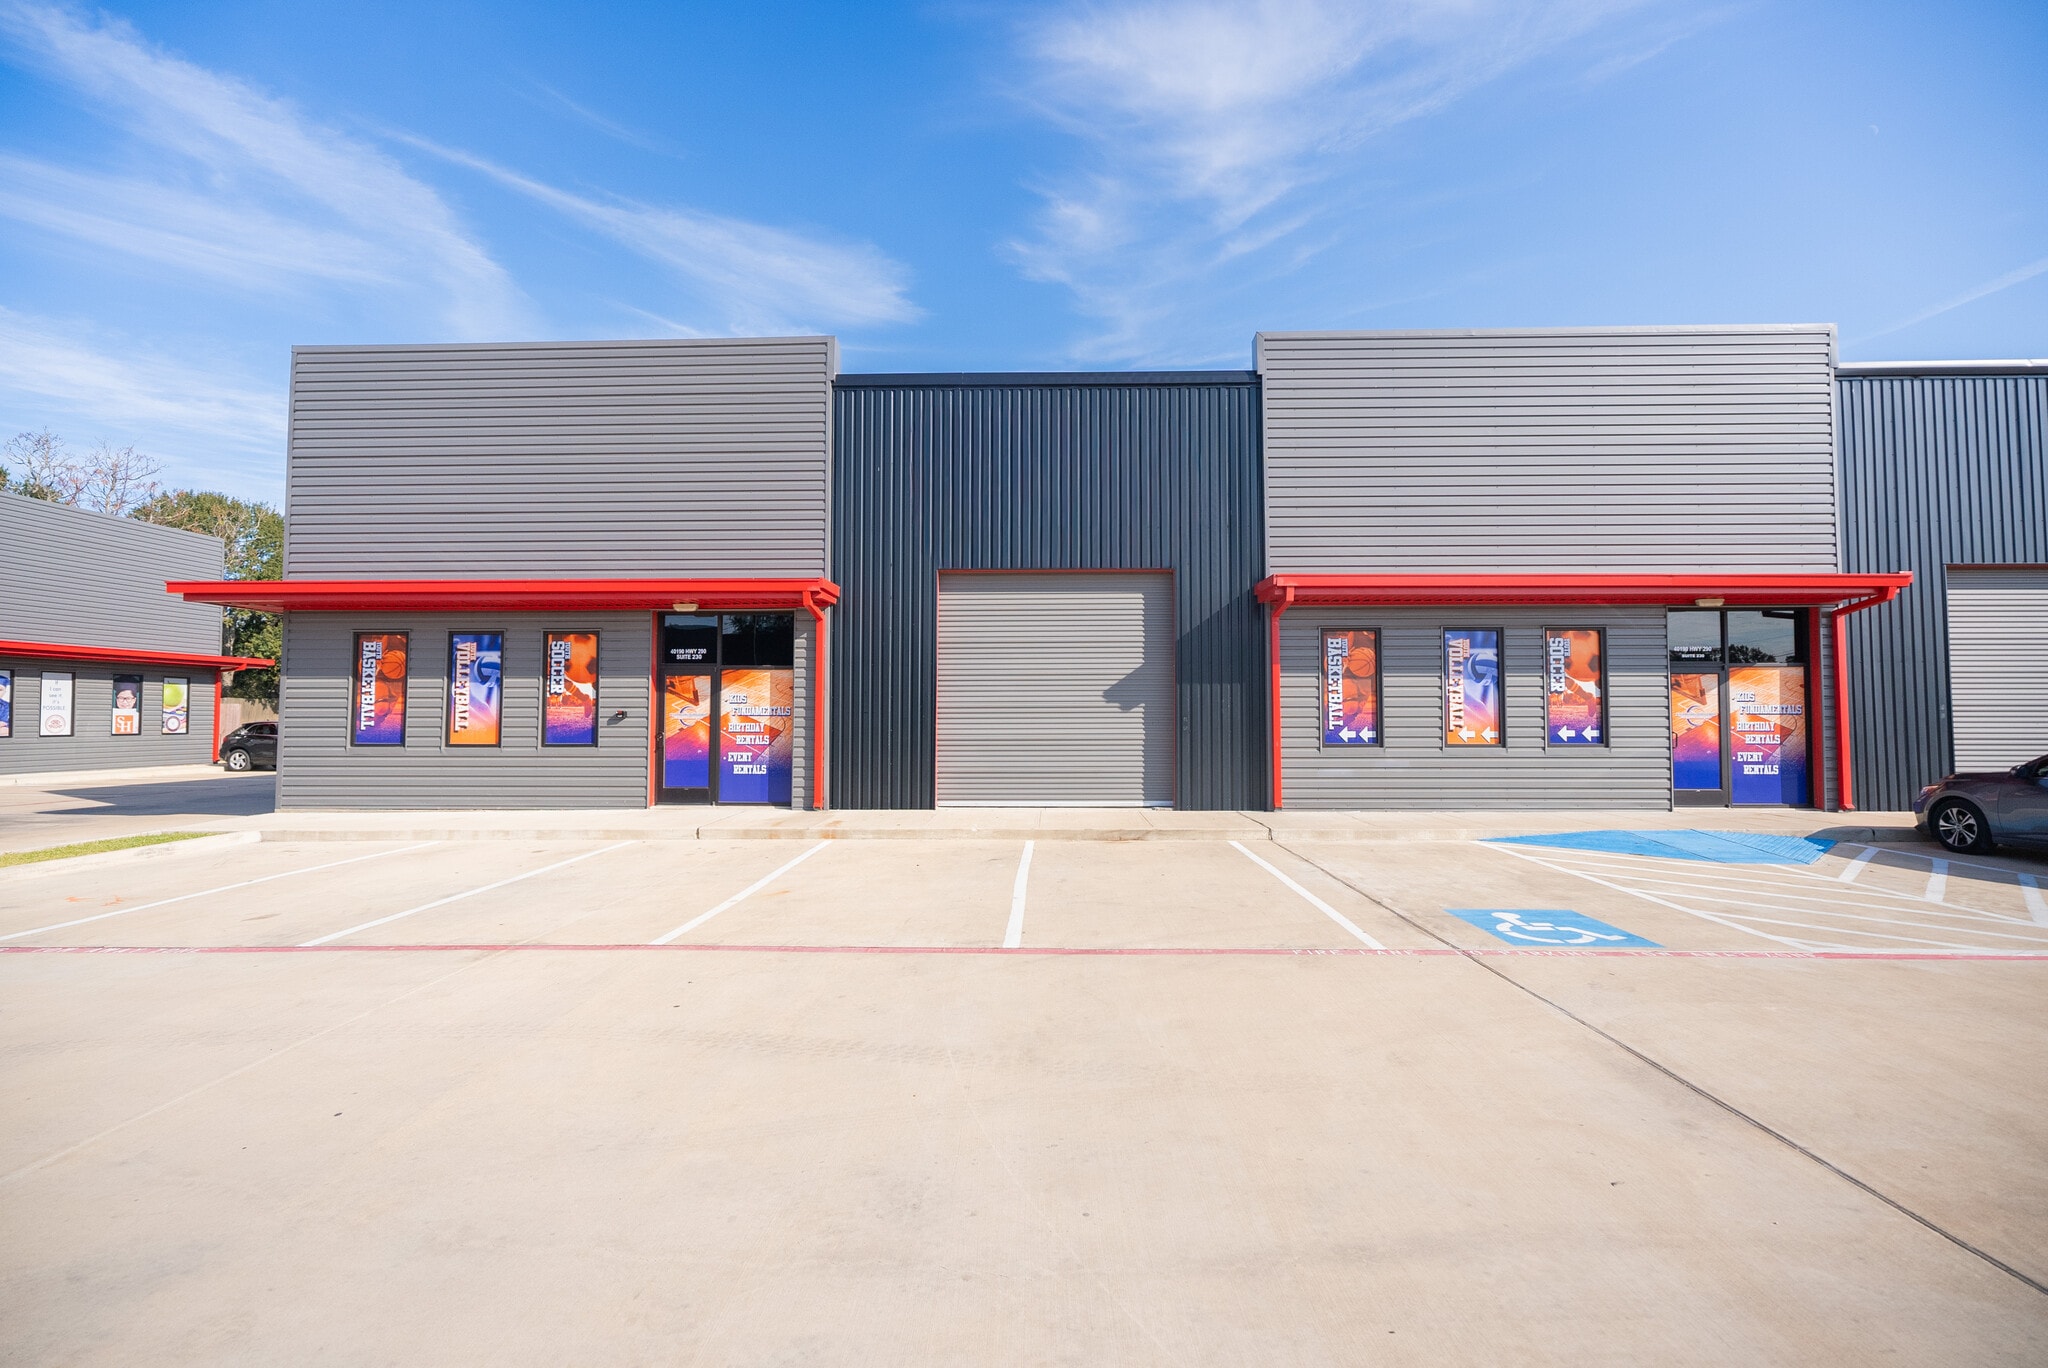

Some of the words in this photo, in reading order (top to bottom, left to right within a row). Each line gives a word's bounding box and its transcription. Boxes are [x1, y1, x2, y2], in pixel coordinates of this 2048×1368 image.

[550, 641, 564, 694] SOCCER
[1549, 638, 1565, 693] SOCCER
[360, 642, 376, 731] BASKETBALL
[454, 642, 470, 732] VOLLEYBALL
[1327, 638, 1343, 731] BASKETBALL
[1448, 638, 1464, 732] VOLLEYBALL
[728, 694, 748, 705] KIDS
[1736, 692, 1756, 702] KIDS
[731, 706, 792, 717] FUNDAMENTALS
[1740, 704, 1803, 715] FUNDAMENTALS
[728, 722, 765, 734] BIRTHDAY
[1736, 721, 1775, 732] BIRTHDAY
[736, 735, 770, 745] RENTALS
[1745, 734, 1782, 745] RENTALS
[727, 752, 752, 762] EVENT
[1737, 752, 1763, 762] EVENT
[733, 764, 767, 775] RENTALS
[1743, 764, 1779, 775] RENTALS
